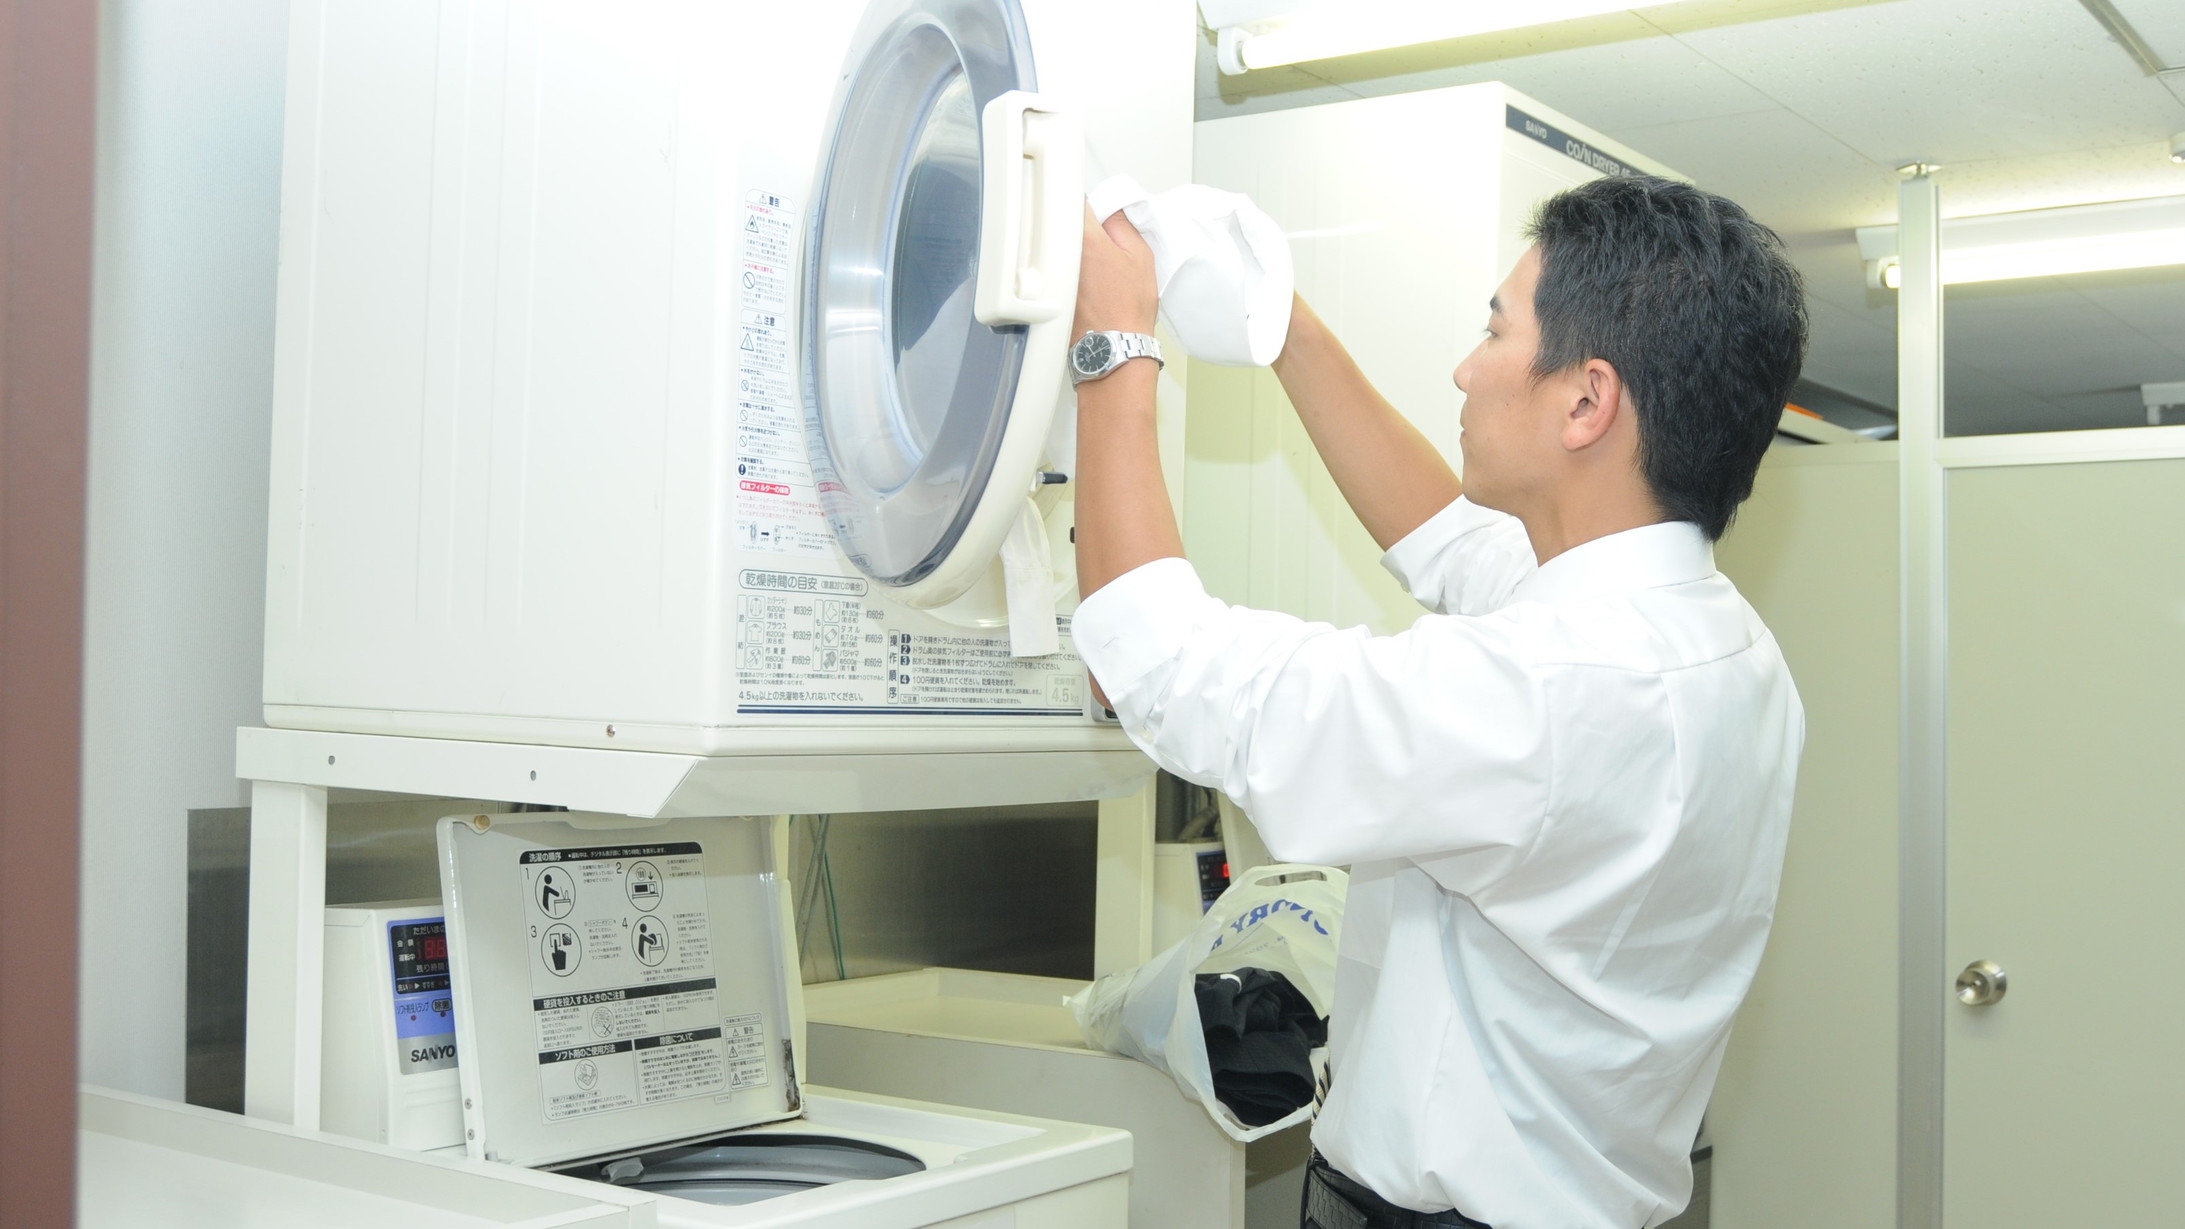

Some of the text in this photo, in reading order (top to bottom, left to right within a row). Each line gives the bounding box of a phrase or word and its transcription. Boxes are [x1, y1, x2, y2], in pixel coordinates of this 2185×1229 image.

[1525, 120, 1548, 139] SANYO
[1592, 153, 1620, 177] DRYER
[763, 315, 775, 326] 注意
[745, 572, 818, 591] 乾燥時間の目安
[840, 625, 861, 634] タオル
[528, 850, 562, 863] 洗濯の順序
[525, 867, 530, 880] 1
[615, 861, 623, 874] 2
[621, 917, 629, 929] 4
[530, 925, 538, 938] 3
[543, 990, 626, 1009] 硬貨を投入するときのご注意
[659, 1032, 694, 1046] 除菌について
[411, 1044, 456, 1063] SANYO
[555, 1043, 616, 1061] ソフト剤のご使用方法
